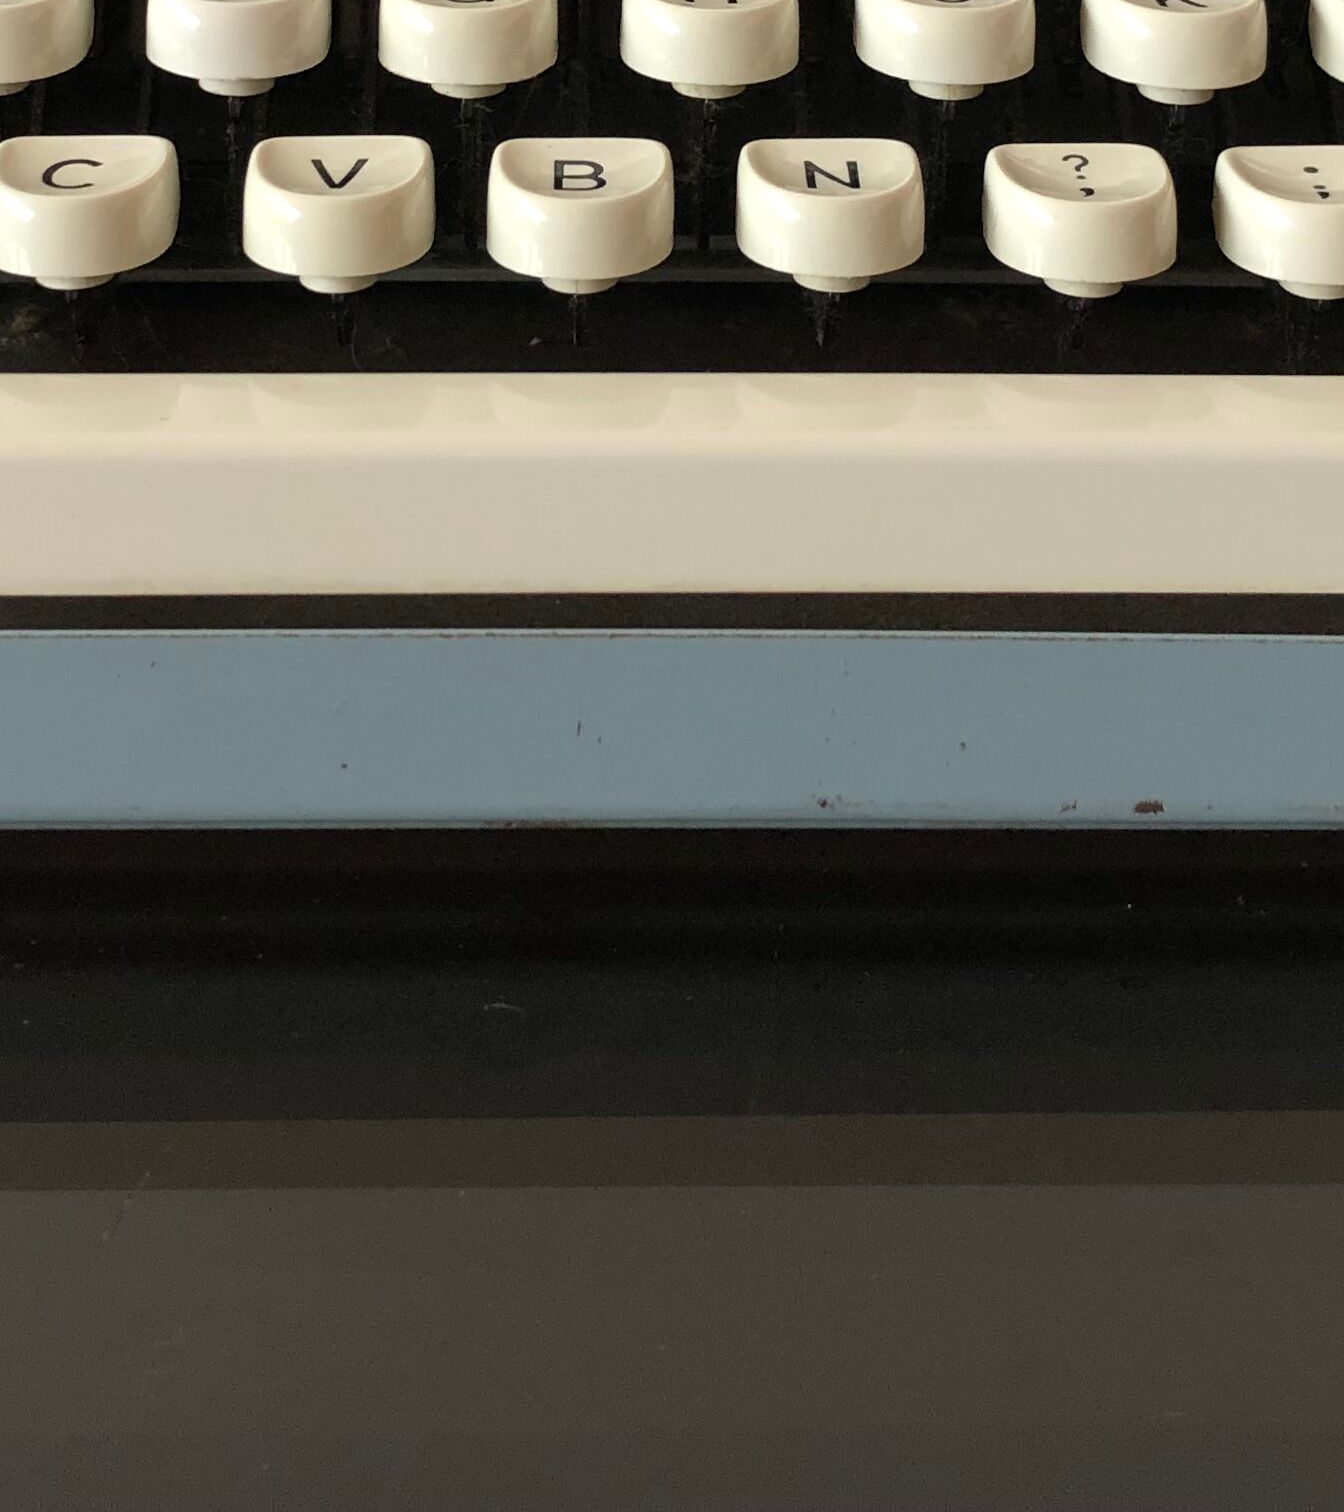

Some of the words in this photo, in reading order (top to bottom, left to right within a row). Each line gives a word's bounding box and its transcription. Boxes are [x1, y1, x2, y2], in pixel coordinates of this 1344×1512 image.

[41, 158, 103, 190] C
[311, 158, 369, 189] V
[553, 159, 607, 192] B
[803, 160, 861, 189] N
